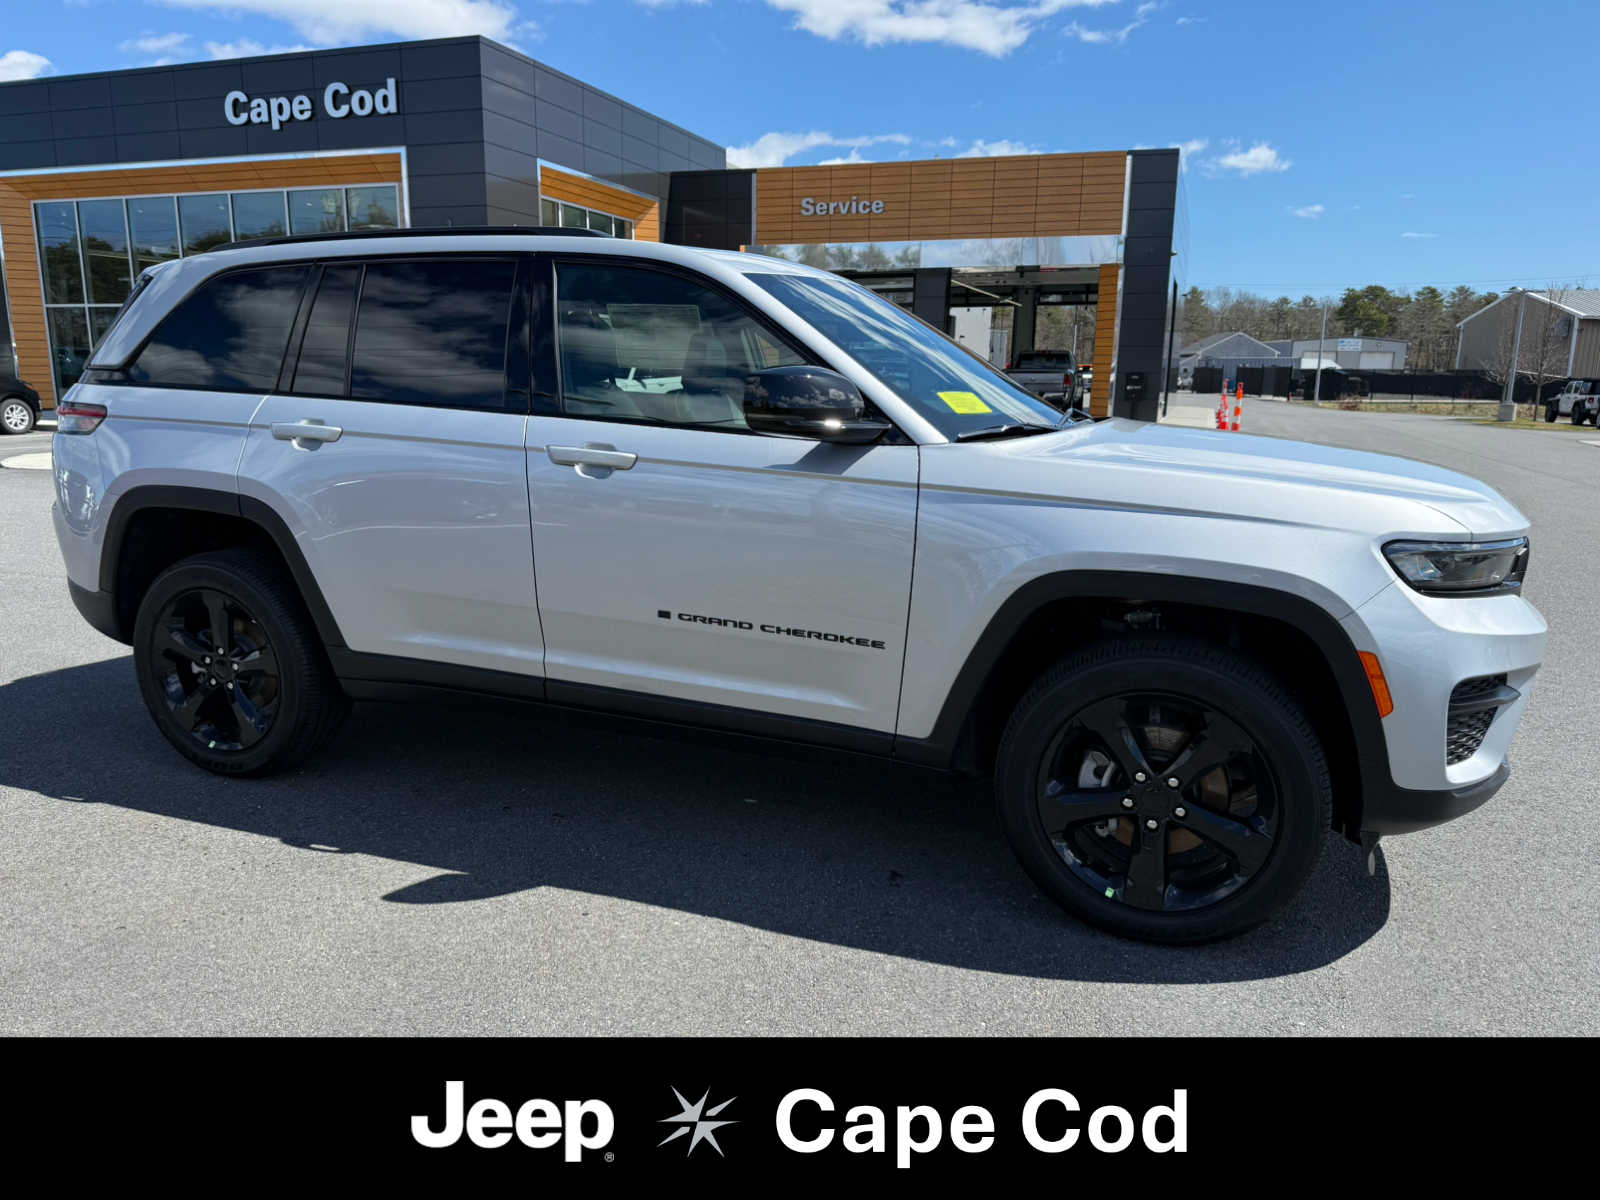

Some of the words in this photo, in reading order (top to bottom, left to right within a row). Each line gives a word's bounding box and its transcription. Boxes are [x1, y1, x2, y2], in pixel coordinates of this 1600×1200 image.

[224, 90, 313, 131] Cape
[323, 77, 398, 119] Cod
[800, 195, 885, 216] Service
[677, 612, 754, 631] GRAND
[759, 624, 886, 650] CHEROKEE
